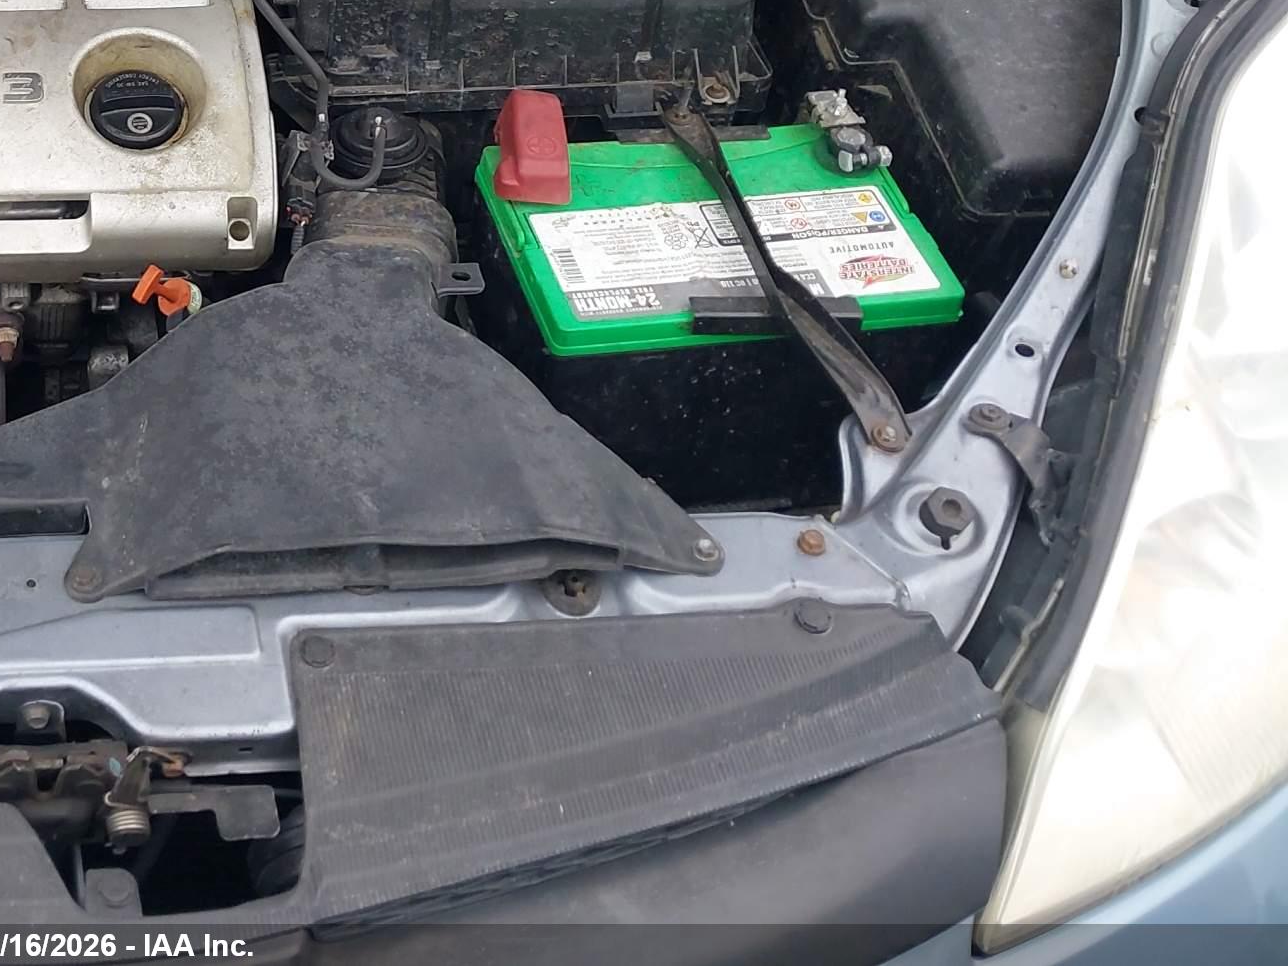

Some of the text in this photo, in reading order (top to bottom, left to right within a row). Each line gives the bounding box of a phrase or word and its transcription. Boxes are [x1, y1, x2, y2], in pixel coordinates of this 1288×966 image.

[792, 226, 869, 238] DANGER/POISON
[829, 241, 895, 254] AUTOMOTIVE
[840, 258, 907, 271] BATTERIES
[839, 265, 916, 280] INTERSTATE
[574, 292, 661, 313] 24-MONTH
